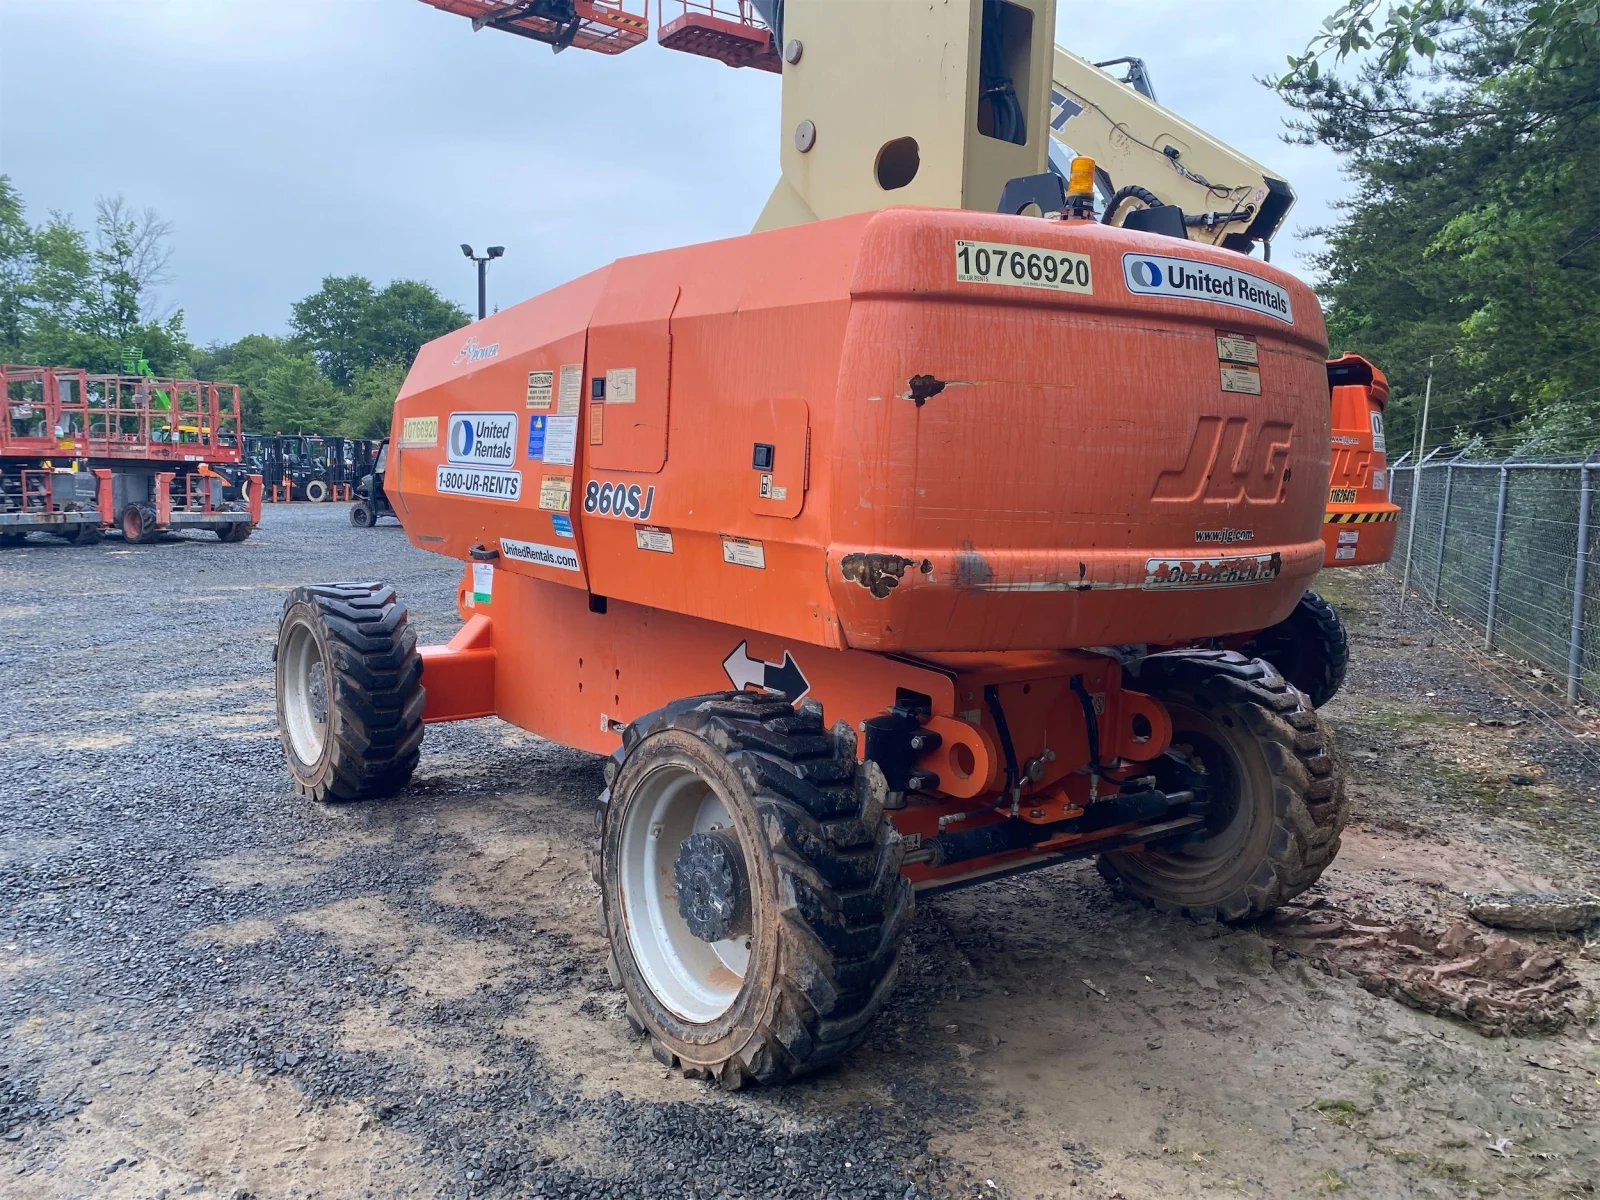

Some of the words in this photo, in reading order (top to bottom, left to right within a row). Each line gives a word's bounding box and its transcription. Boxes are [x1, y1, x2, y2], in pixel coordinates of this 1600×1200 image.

[958, 247, 1089, 287] 10766920
[1168, 265, 1233, 297] United
[1237, 278, 1287, 314] Rentals
[404, 420, 437, 438] 10766920
[476, 421, 510, 438] United
[474, 441, 511, 459] Rentals
[1151, 415, 1294, 504] JLG
[439, 472, 518, 496] 1-800-UR-RENTS
[584, 480, 655, 520] 860SJ
[1195, 528, 1253, 543] www.jlg.com
[502, 542, 578, 568] UnitedRentals.com
